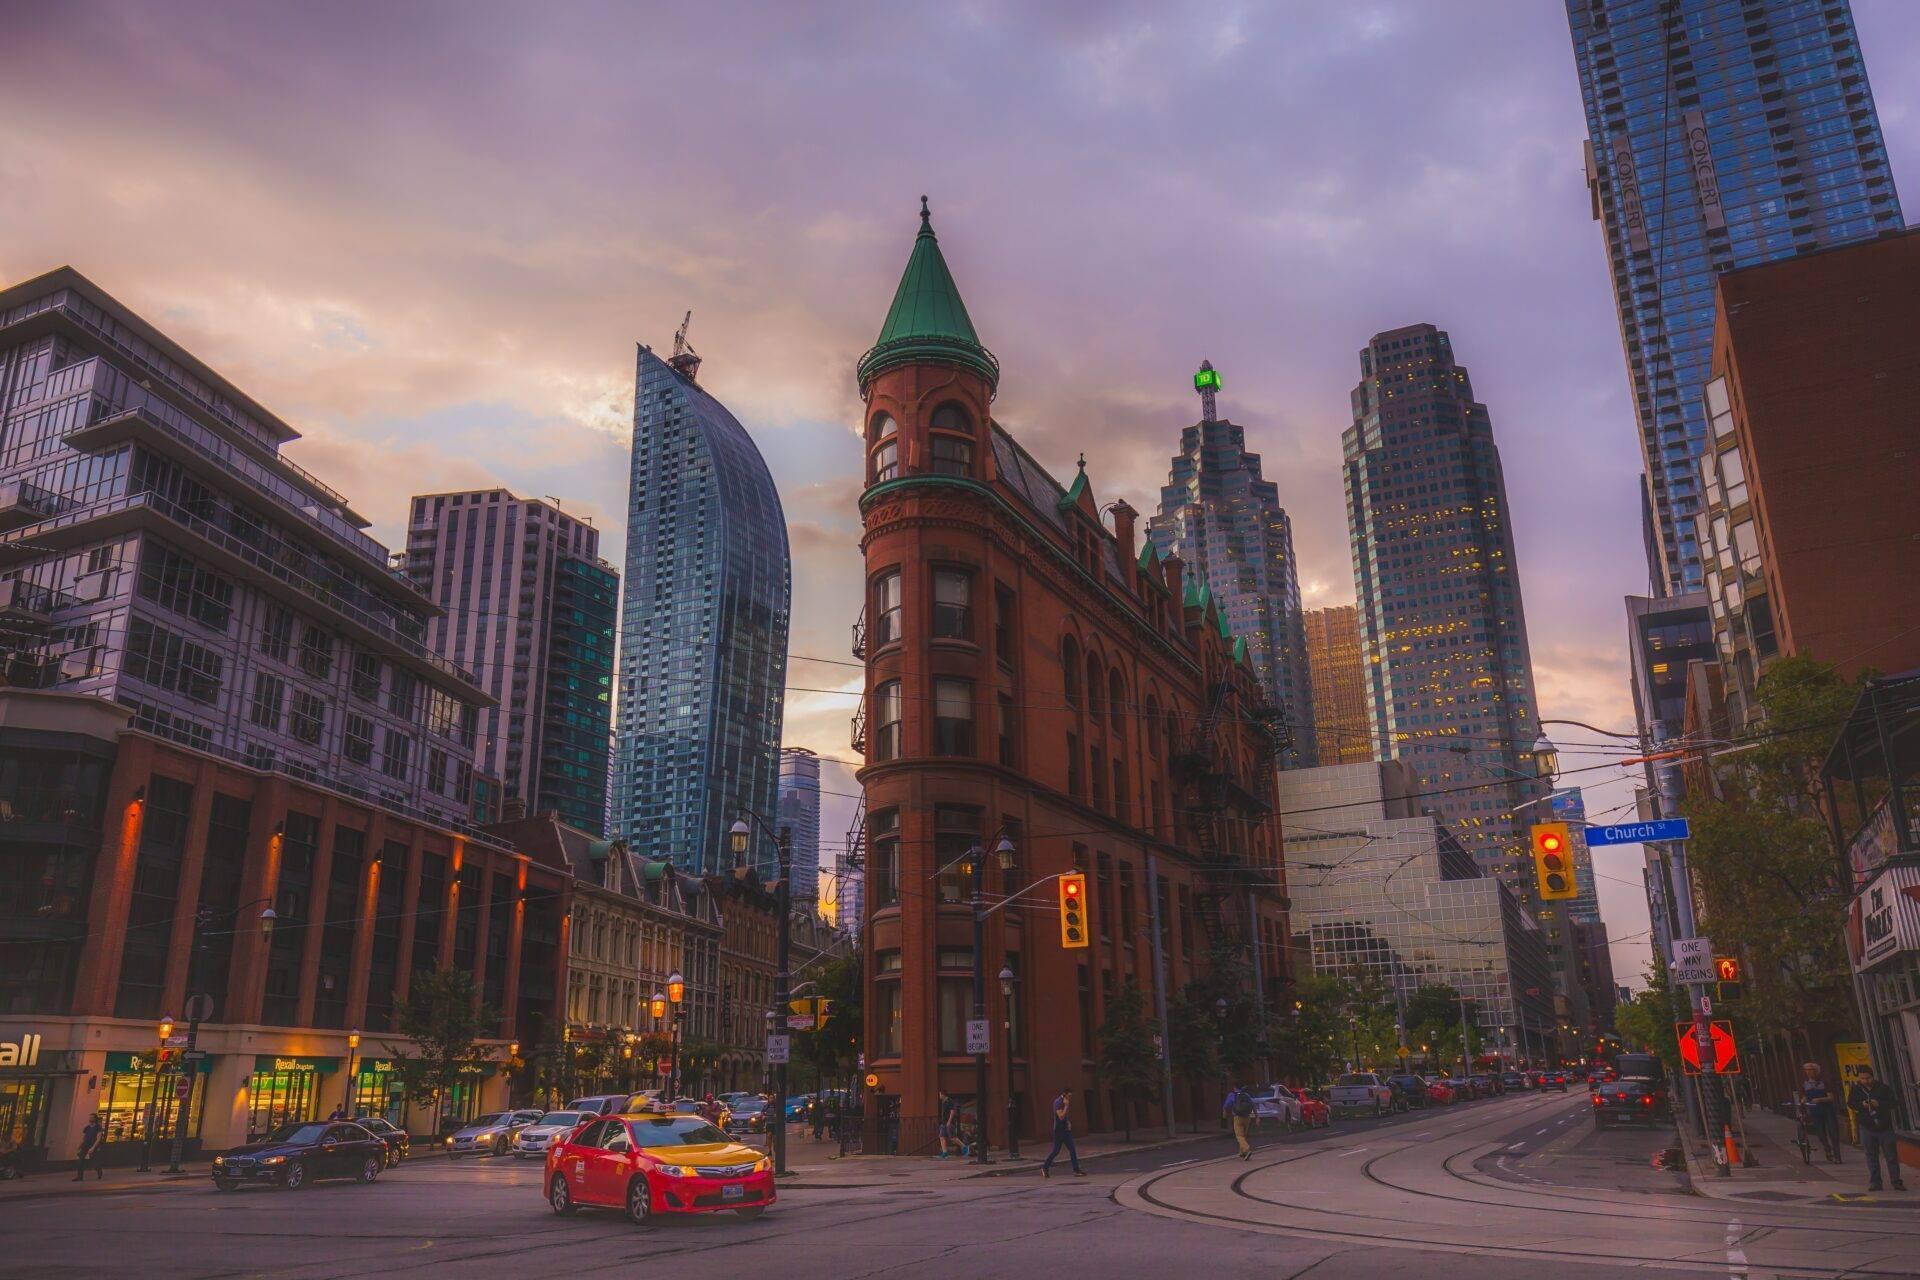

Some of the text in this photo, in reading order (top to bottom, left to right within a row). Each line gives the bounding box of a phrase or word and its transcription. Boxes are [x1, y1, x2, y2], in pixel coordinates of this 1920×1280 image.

[1690, 127, 1719, 207] CONCERT
[1616, 151, 1643, 231] CONCERT
[1604, 822, 1666, 840] Church St
[1864, 904, 1893, 947] WORKS
[1681, 941, 1701, 952] ONE
[1683, 954, 1702, 966] WAY
[1677, 968, 1714, 981] BEGINS
[971, 1022, 984, 1031] ONE
[972, 1032, 984, 1041] WAY
[968, 1042, 989, 1051] BEGINS
[275, 1058, 297, 1071] Rexall
